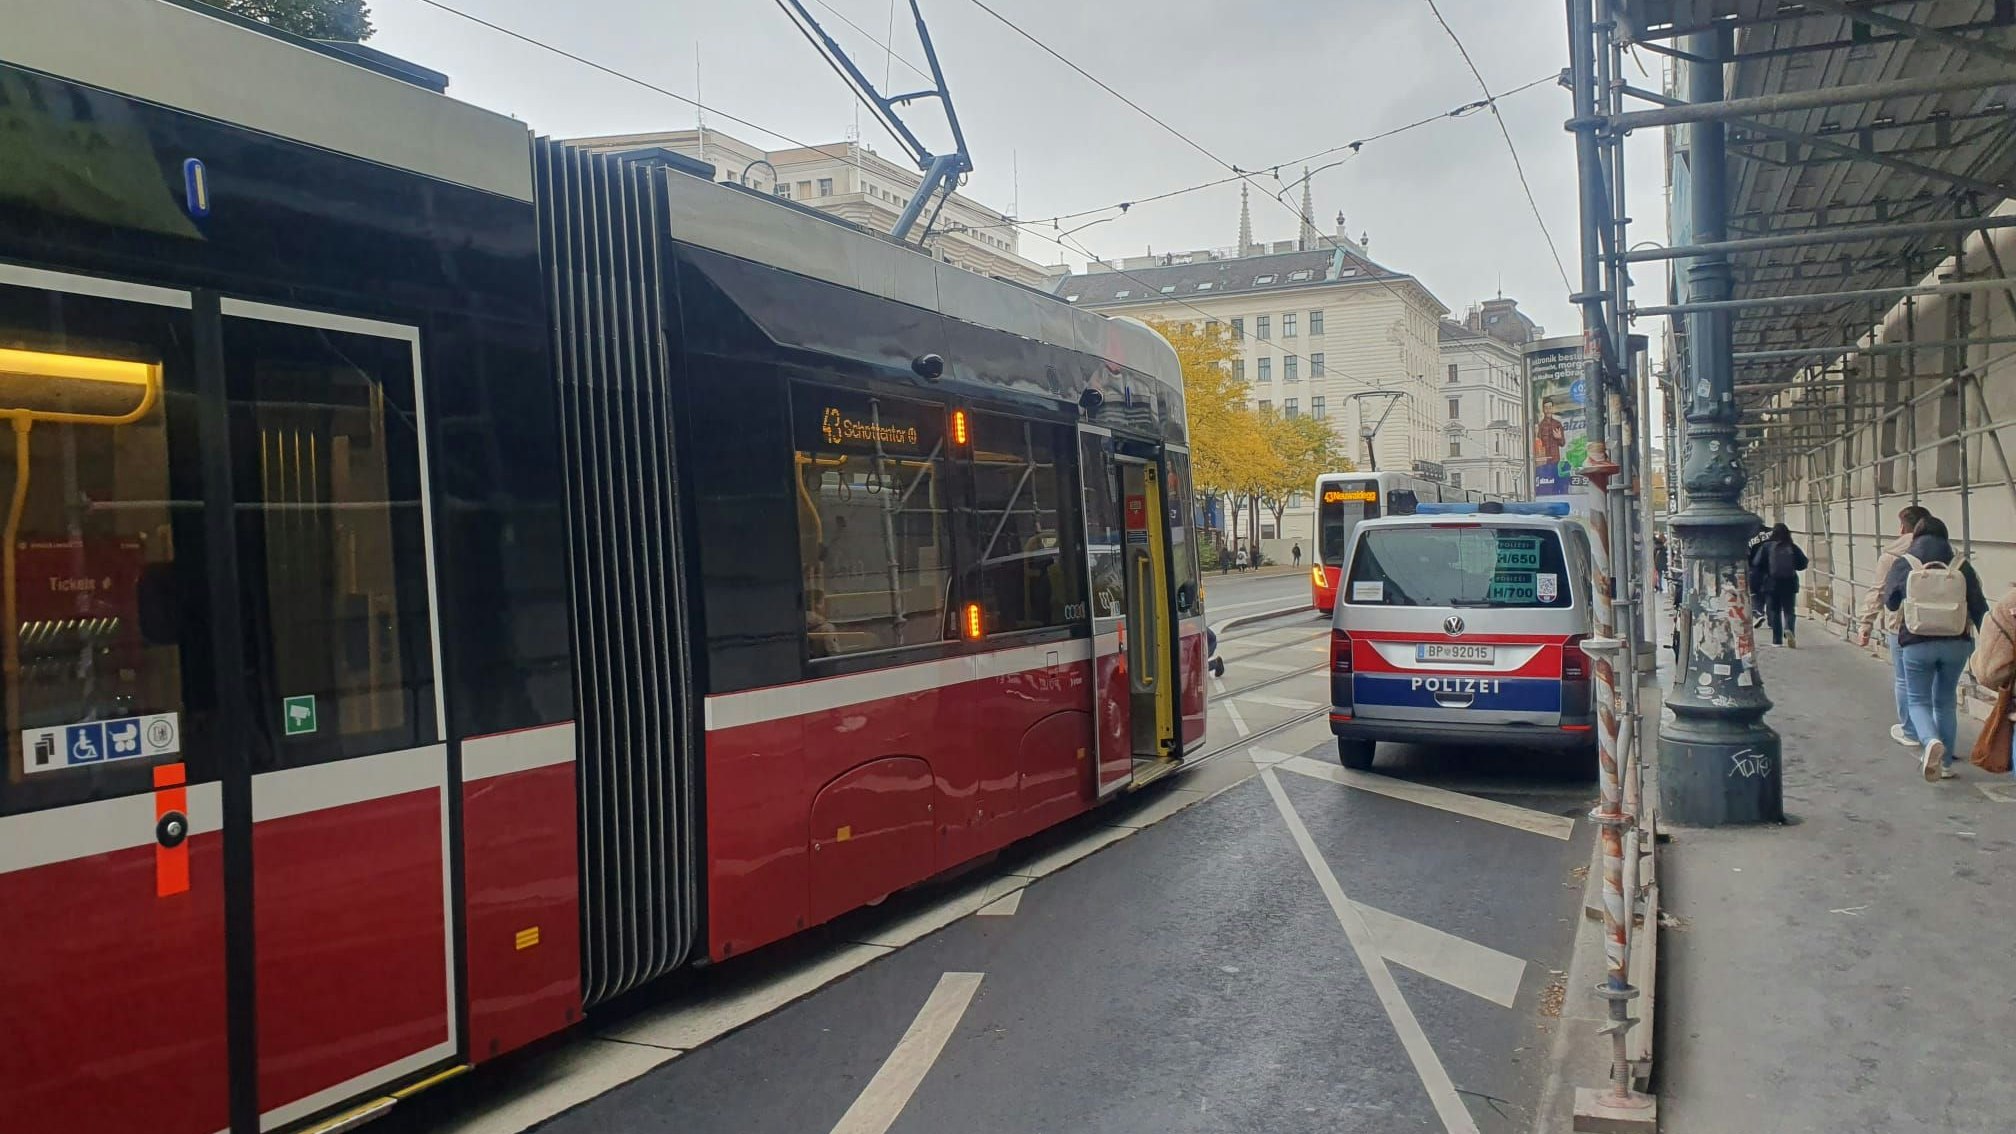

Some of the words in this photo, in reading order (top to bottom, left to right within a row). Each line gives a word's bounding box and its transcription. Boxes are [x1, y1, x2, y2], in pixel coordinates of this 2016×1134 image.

[822, 407, 842, 444] 43
[1497, 553, 1537, 565] H/650
[1493, 587, 1533, 599] H/700
[1428, 645, 1443, 657] BP
[1452, 646, 1488, 659] 92015
[1411, 677, 1499, 694] POLIZEI
